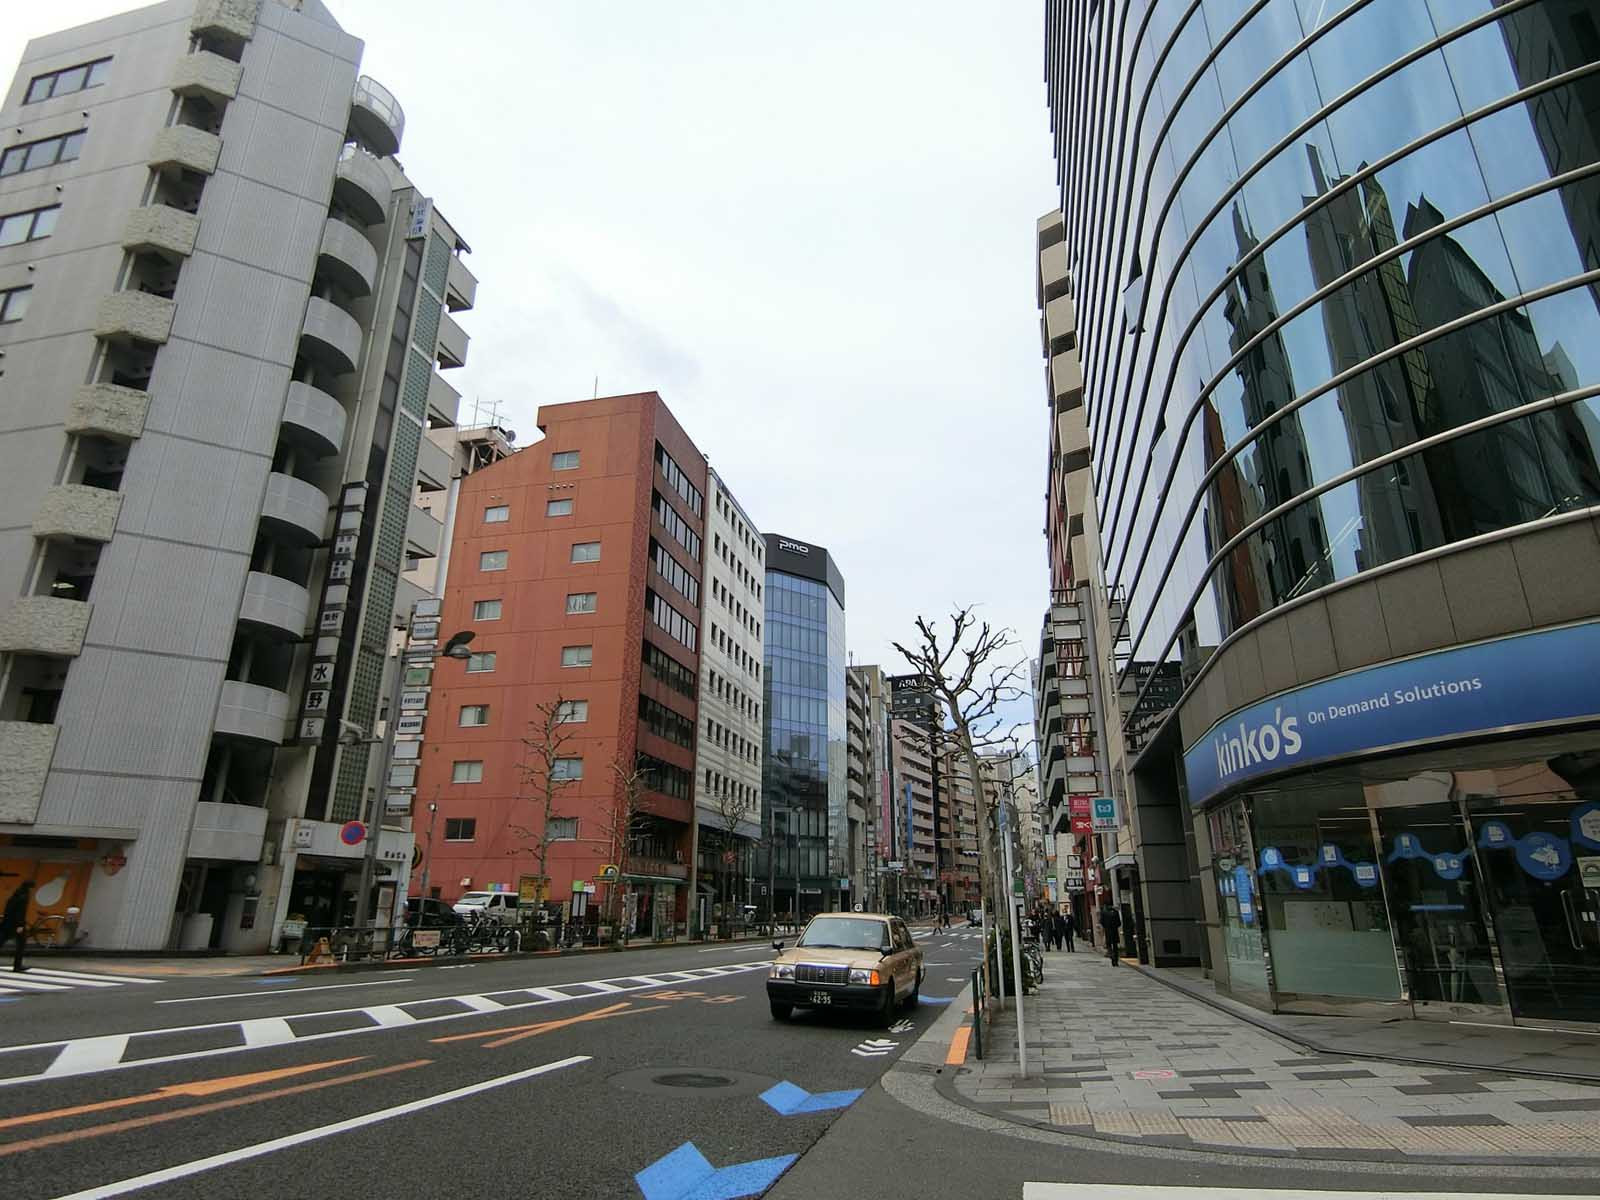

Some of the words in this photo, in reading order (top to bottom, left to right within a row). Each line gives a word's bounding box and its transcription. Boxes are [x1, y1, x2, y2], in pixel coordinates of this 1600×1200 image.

[779, 540, 809, 553] pmo
[898, 679, 918, 688] APA
[1307, 711, 1326, 725] On
[1328, 692, 1390, 720] Demand
[1394, 677, 1482, 705] Solutions
[1215, 706, 1302, 779] kinko's
